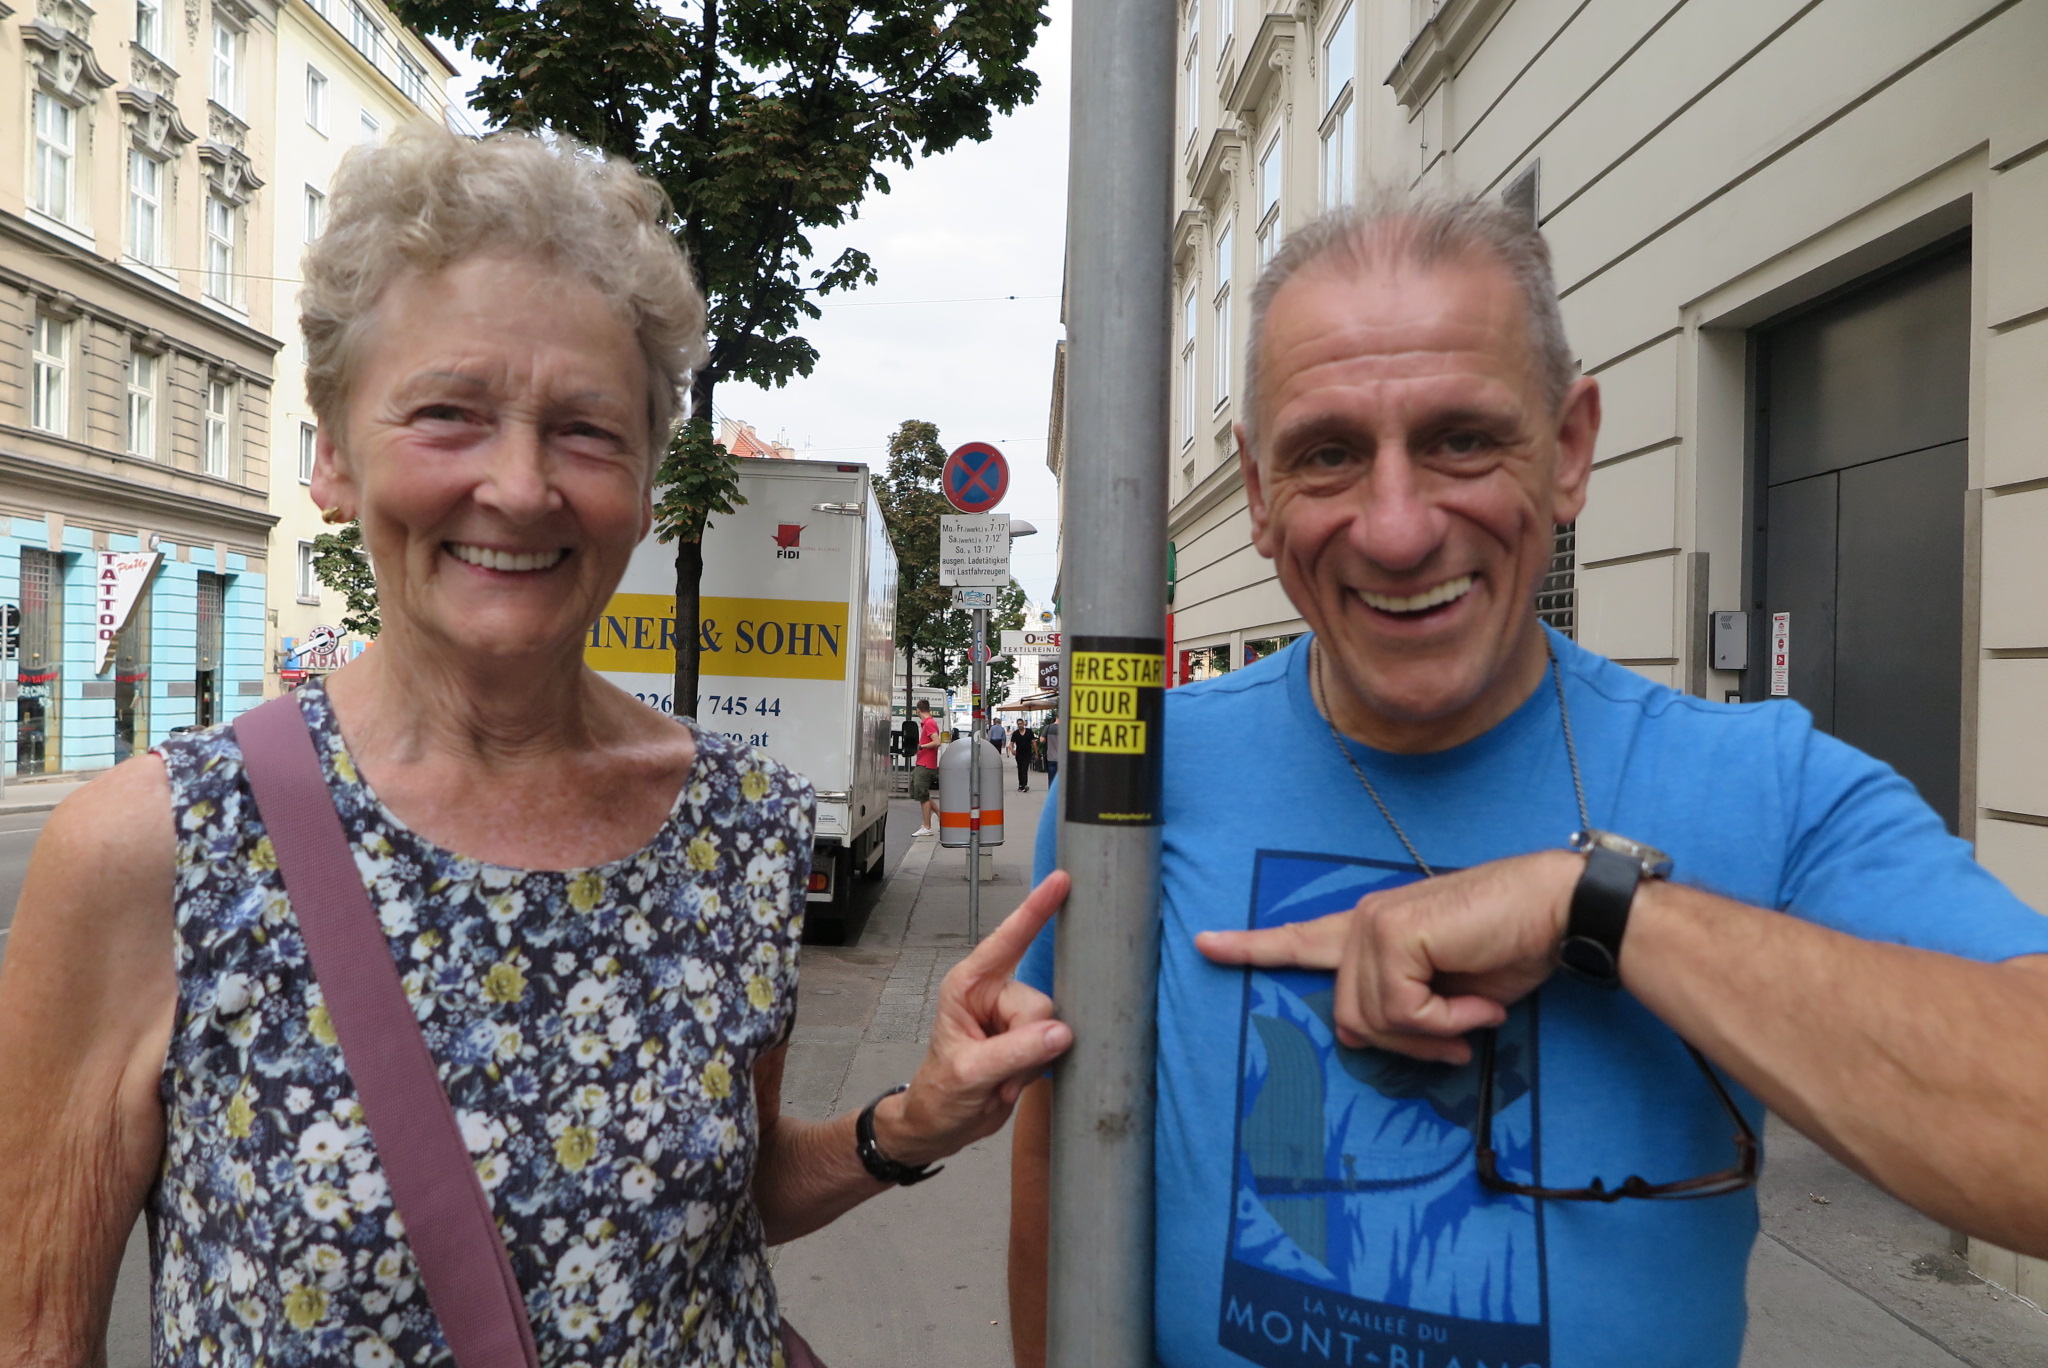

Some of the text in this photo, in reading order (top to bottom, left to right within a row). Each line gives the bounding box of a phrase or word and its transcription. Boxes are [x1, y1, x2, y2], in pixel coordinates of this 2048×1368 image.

[776, 550, 800, 560] FIDI
[944, 567, 1006, 577] mit Lastfahrzeugen
[99, 553, 119, 641] TATTOO
[698, 618, 724, 652] &
[735, 620, 842, 658] SOHN
[1040, 663, 1059, 676] CAFE
[1045, 675, 1058, 687] 19
[708, 695, 748, 716] 745
[755, 697, 781, 717] 44
[1075, 689, 1131, 715] YOUR
[1074, 722, 1141, 748] HEART
[1226, 1294, 1544, 1368] MONT-BL
[1303, 1296, 1326, 1317] LA
[1417, 1322, 1449, 1344] DU
